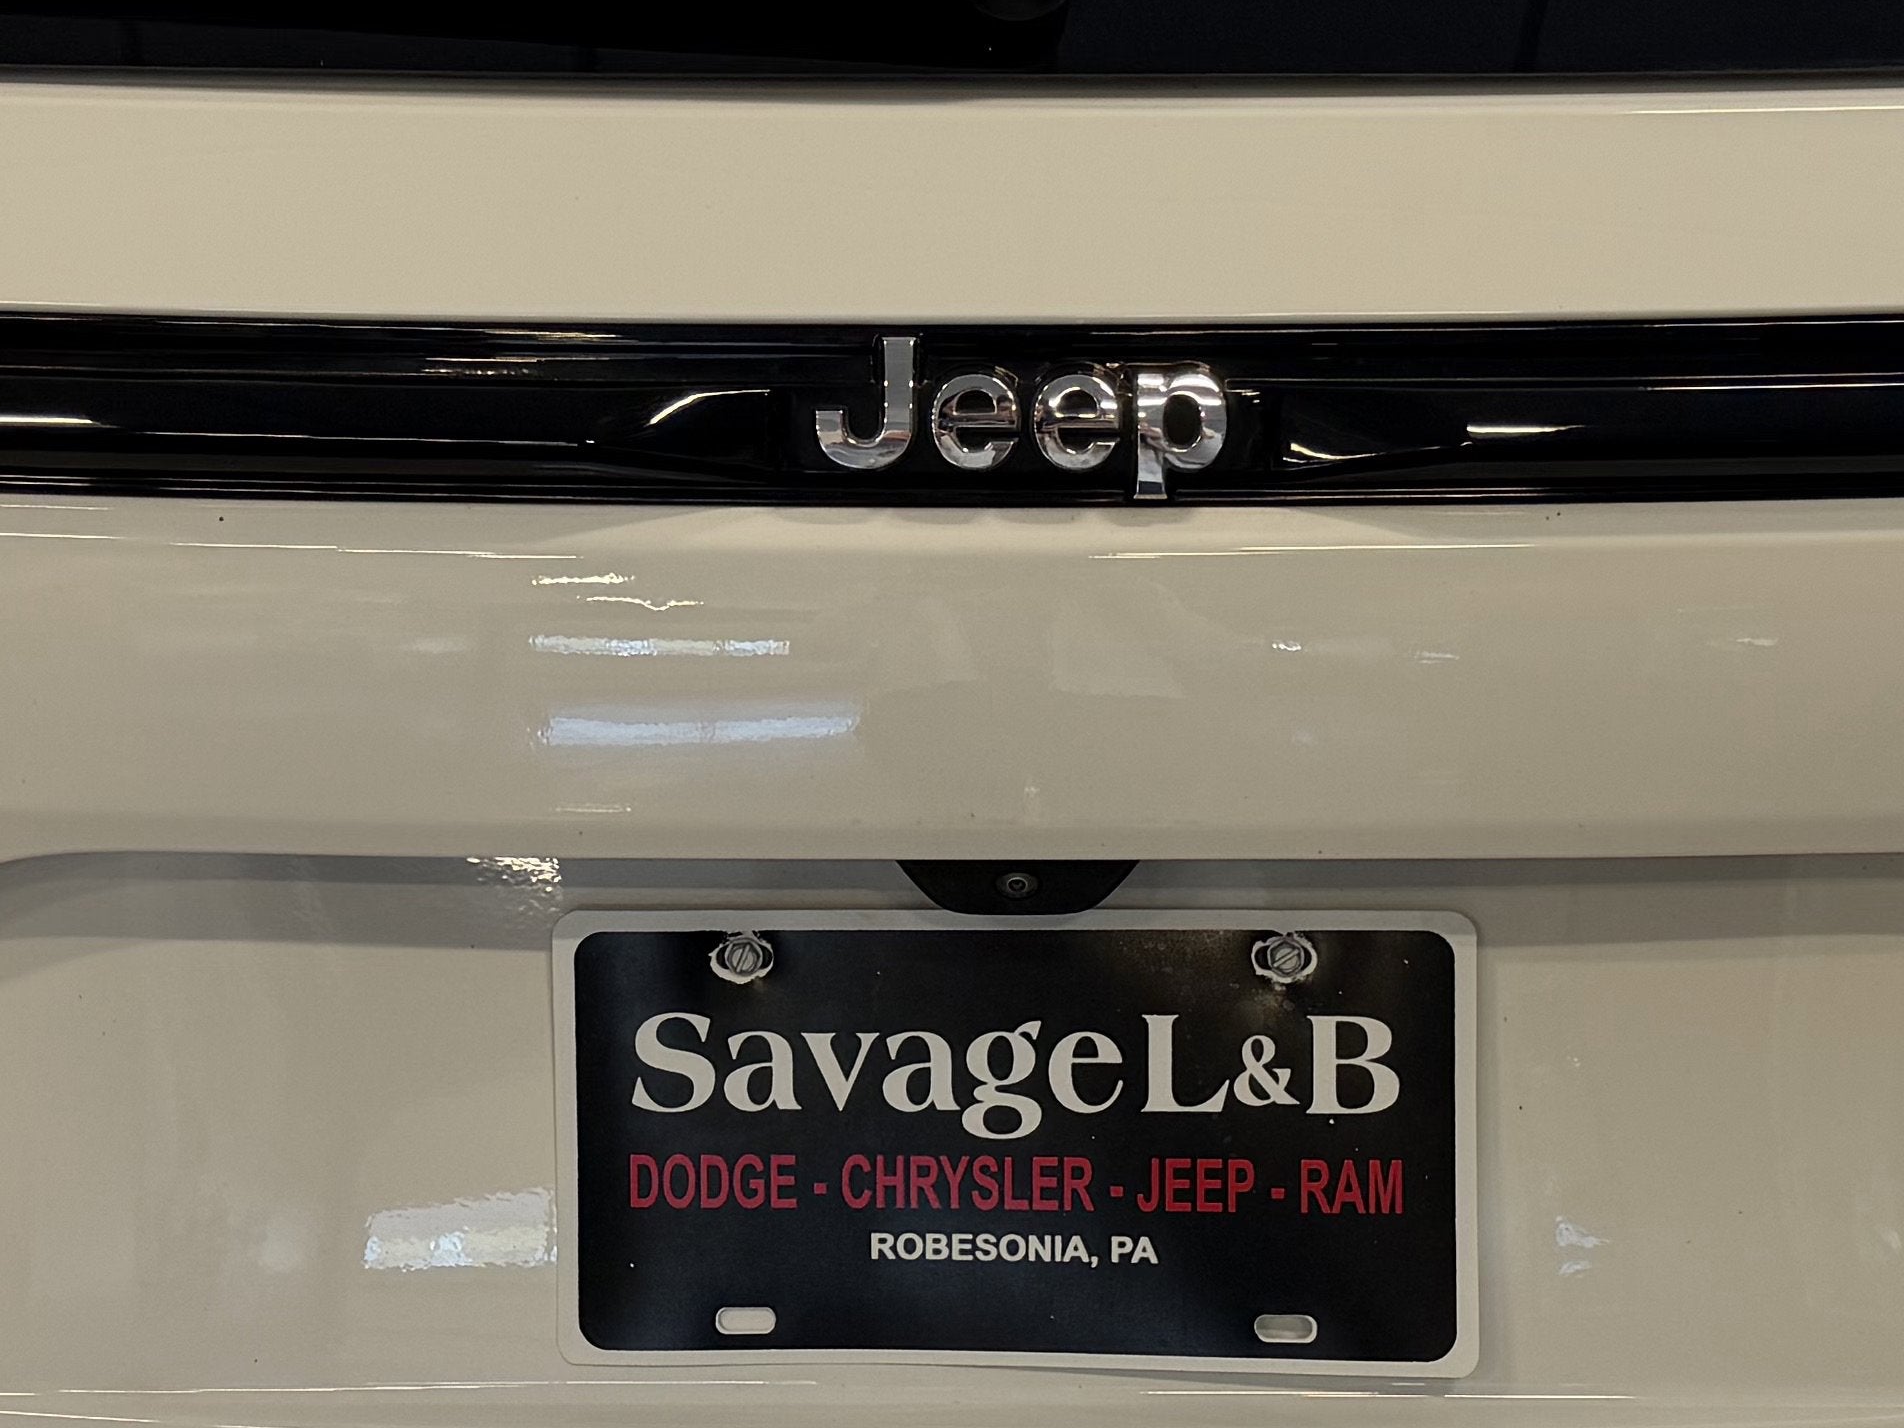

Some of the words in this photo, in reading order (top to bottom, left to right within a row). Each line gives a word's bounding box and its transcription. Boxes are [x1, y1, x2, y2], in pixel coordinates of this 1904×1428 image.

[815, 335, 1227, 500] Jeep
[629, 1153, 798, 1209] DODGE
[841, 1154, 1095, 1212] CHRYSLER
[1136, 1158, 1257, 1214] JEEP
[1299, 1159, 1404, 1215] RAM
[869, 1232, 1099, 1269] ROBESONIA,
[1110, 1235, 1159, 1264] PA
